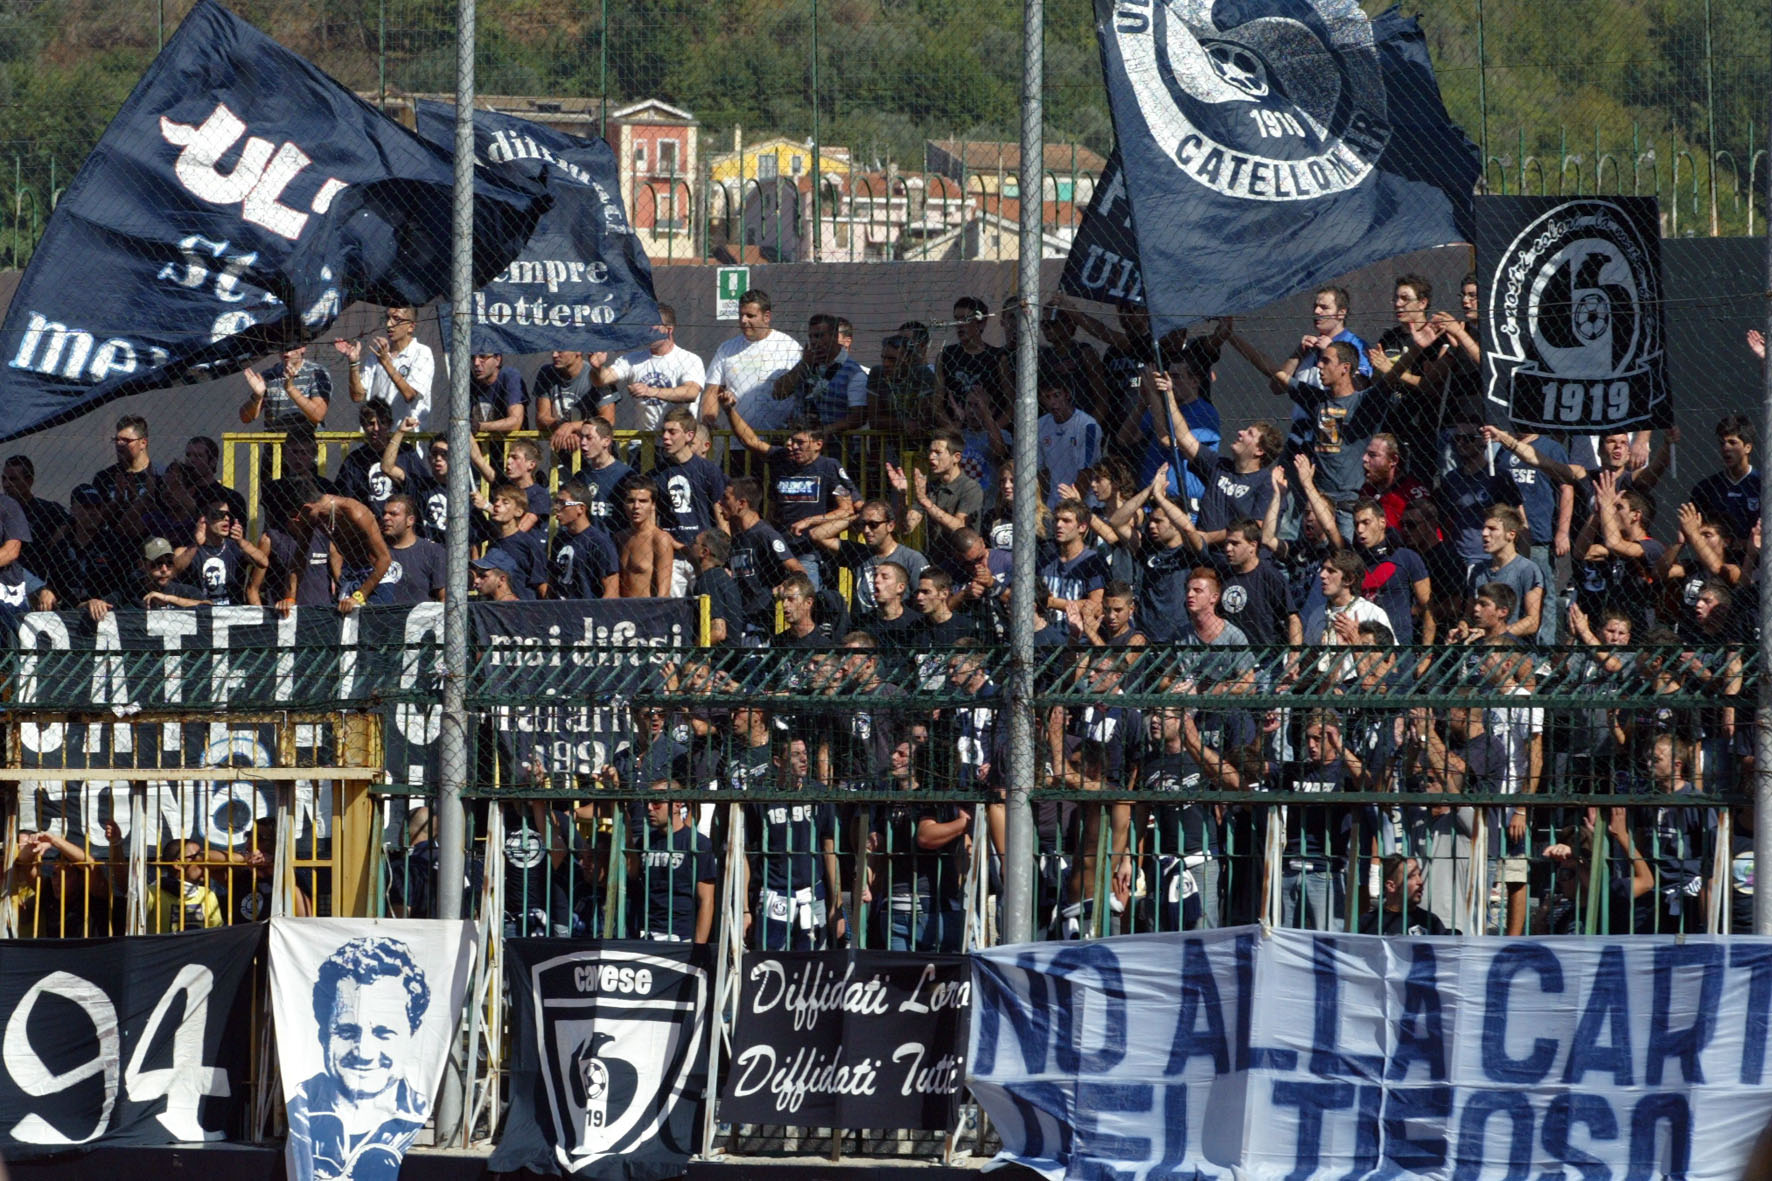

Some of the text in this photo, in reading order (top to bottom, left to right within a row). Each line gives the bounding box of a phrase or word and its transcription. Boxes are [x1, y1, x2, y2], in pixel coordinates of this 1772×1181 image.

[1175, 133, 1332, 198] CATELLO
[493, 259, 609, 293] empre
[1542, 381, 1630, 422] 1919
[489, 625, 562, 667] mai
[574, 964, 653, 995] cavese
[750, 959, 890, 1031] Diffidati
[971, 943, 1128, 1076] NO
[1161, 932, 1447, 1082] ALLA
[2, 963, 231, 1145] 94
[733, 1041, 963, 1113] Diffidati Tutti
[585, 1109, 604, 1128] 19
